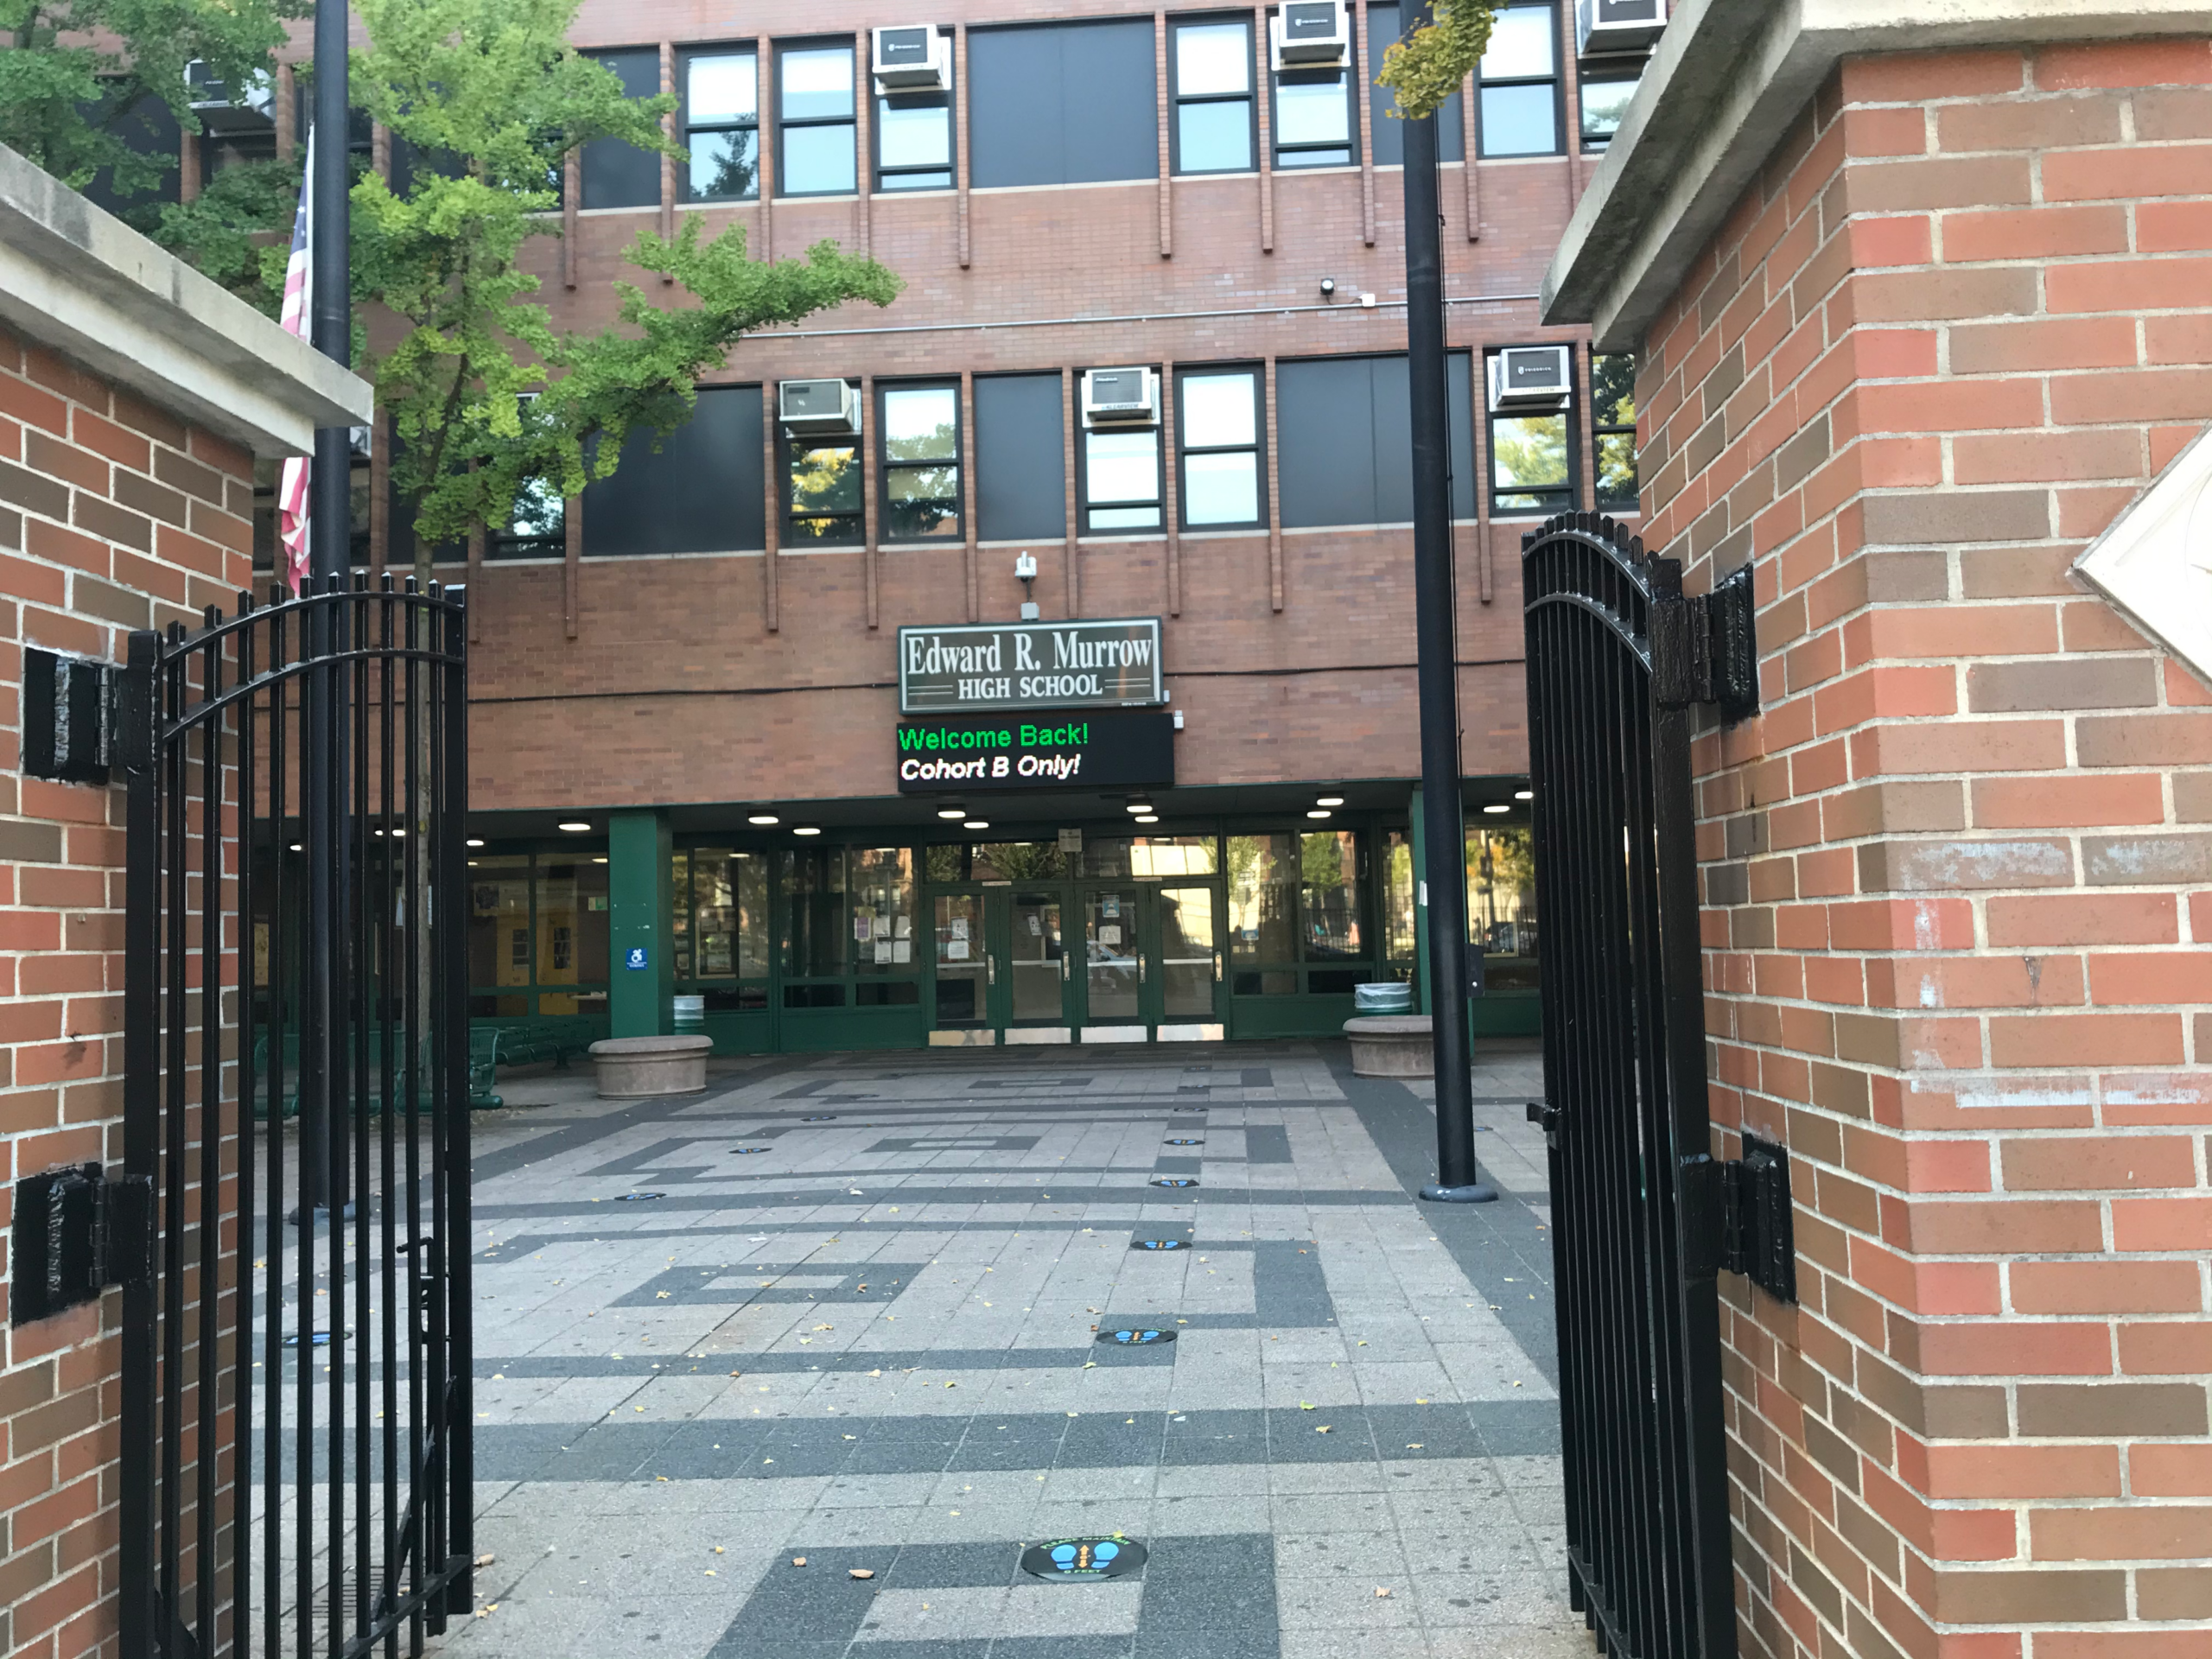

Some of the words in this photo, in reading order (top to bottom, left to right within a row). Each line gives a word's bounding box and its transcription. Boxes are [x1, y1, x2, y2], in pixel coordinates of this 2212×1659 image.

[907, 633, 1001, 675] Edward
[1014, 632, 1041, 671] R.
[1052, 631, 1152, 670] Murrow
[958, 677, 1011, 699] HIGH
[1020, 674, 1103, 697] SCHOOL
[899, 728, 1011, 750] Welcome
[1020, 723, 1088, 746] Back!
[901, 758, 986, 780] Cohort
[992, 756, 1009, 777] B
[1018, 754, 1080, 779] Only!
